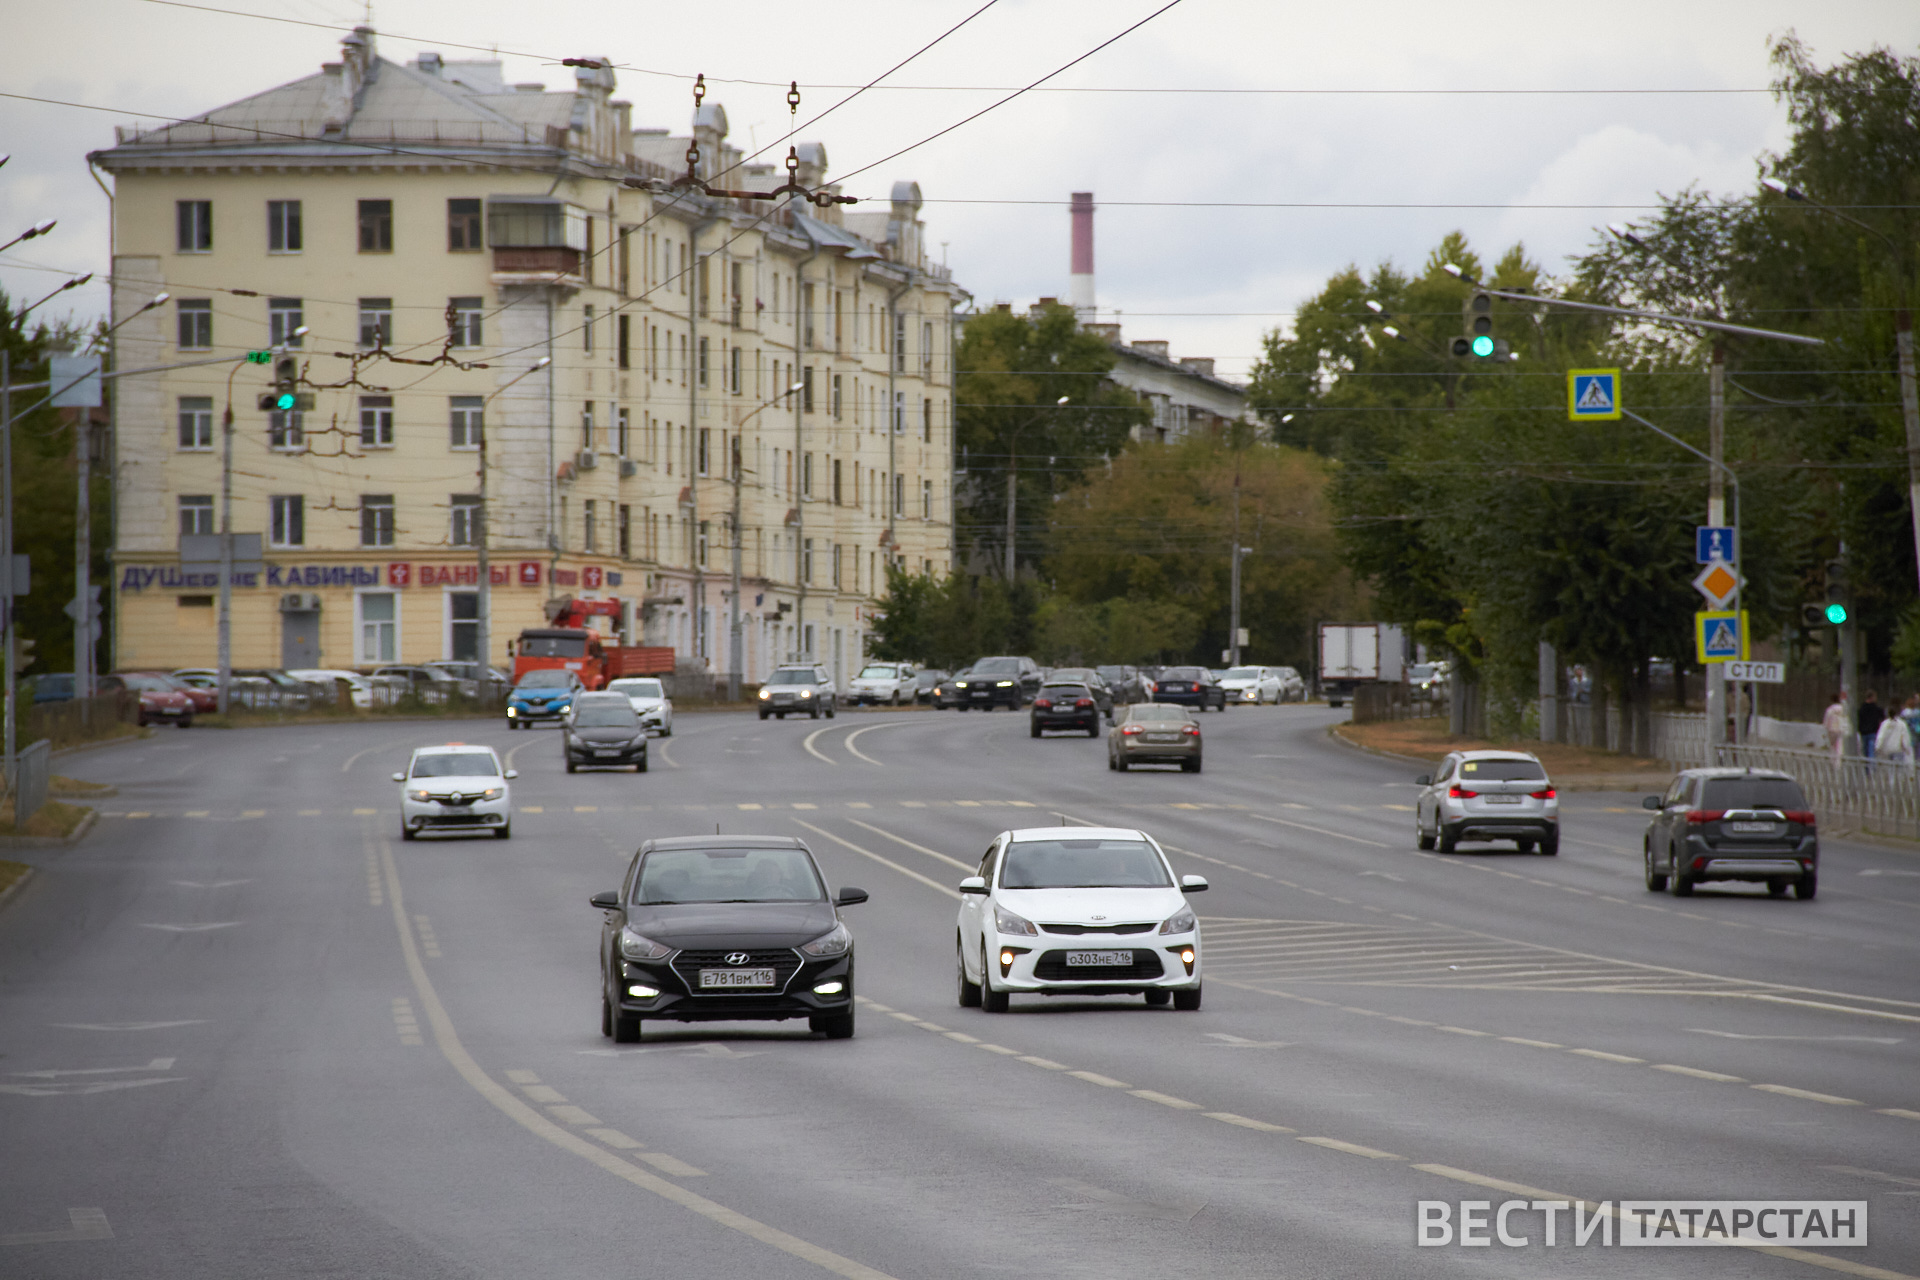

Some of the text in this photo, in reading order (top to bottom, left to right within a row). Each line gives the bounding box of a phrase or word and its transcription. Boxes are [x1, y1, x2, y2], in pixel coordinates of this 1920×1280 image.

[121, 565, 379, 591] ДУШЕВЕ КАБИНЫ
[1731, 663, 1777, 679] СТОП
